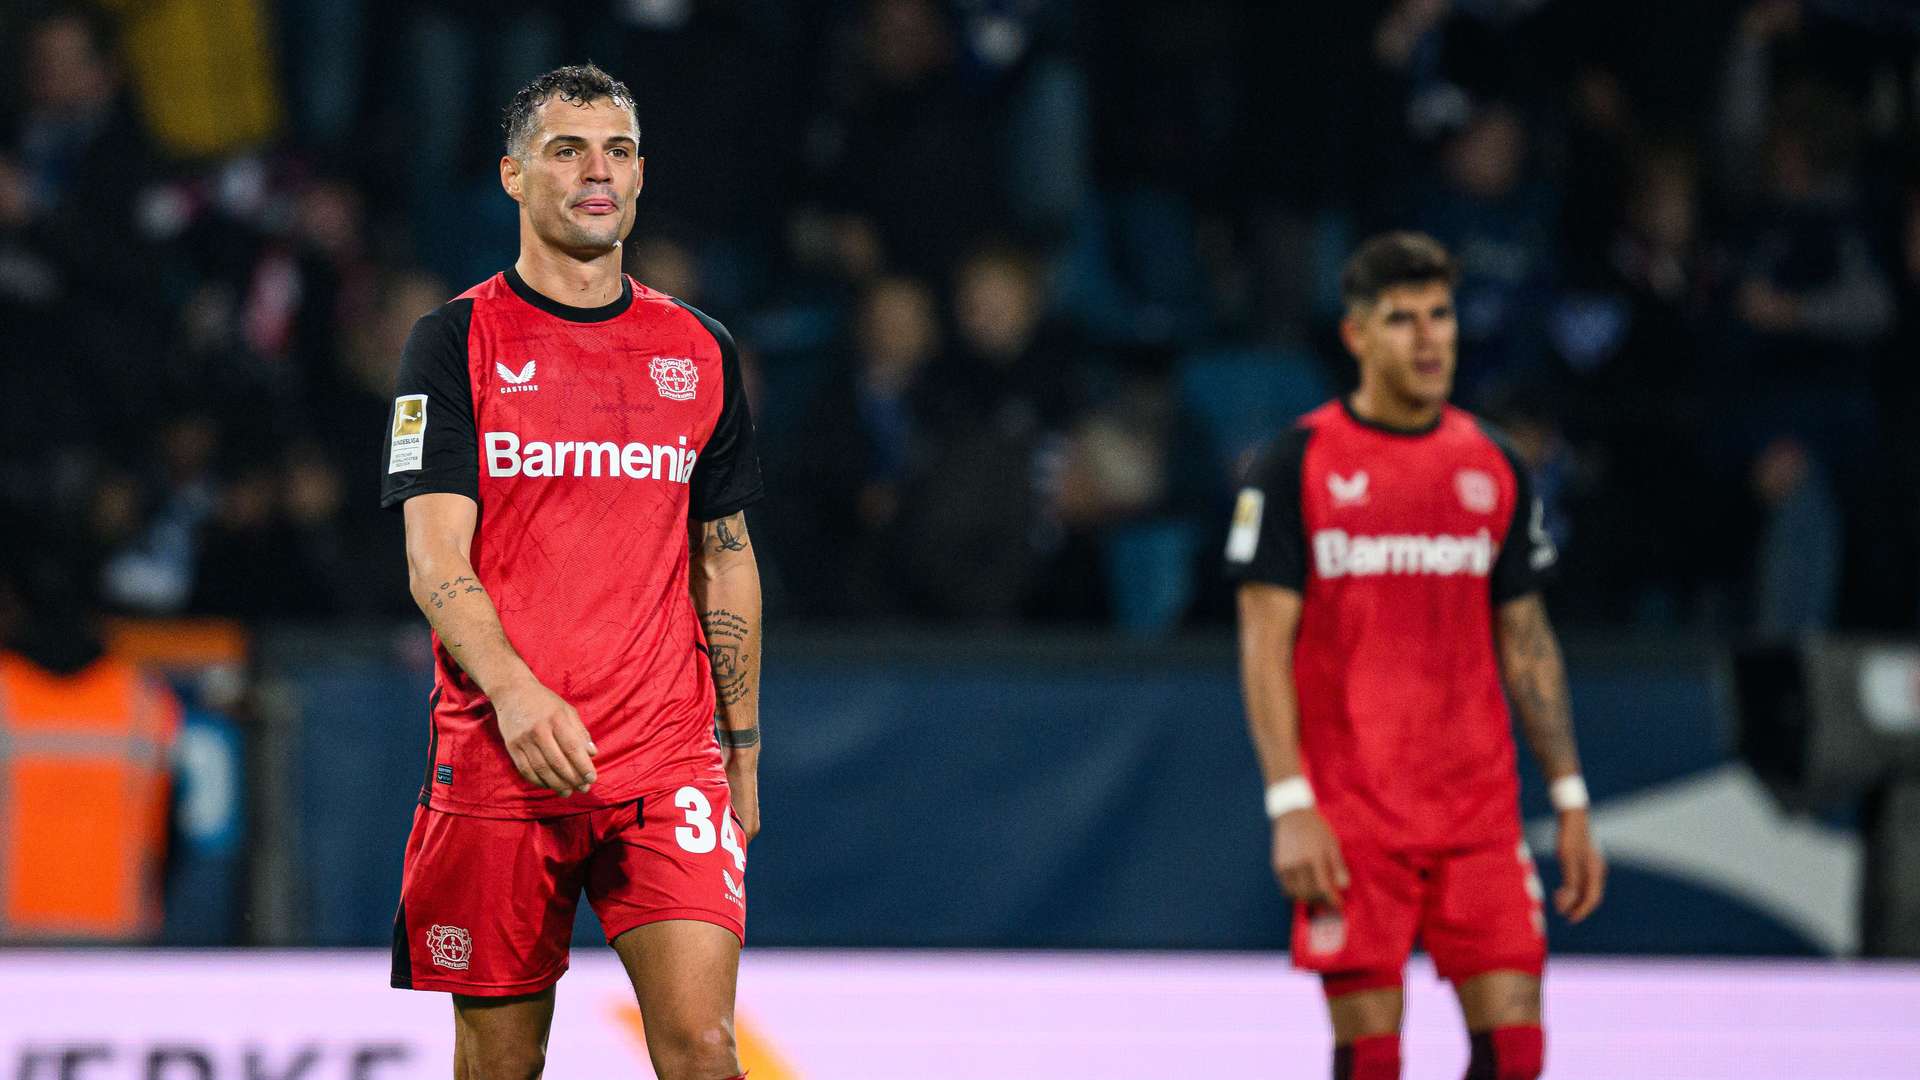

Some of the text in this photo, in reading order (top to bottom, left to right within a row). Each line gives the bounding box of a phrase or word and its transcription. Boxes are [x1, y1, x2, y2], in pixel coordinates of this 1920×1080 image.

[500, 384, 539, 394] CASTORE
[484, 431, 697, 484] Barmenia
[1313, 527, 1494, 579] Barmeni
[675, 786, 746, 873] 34
